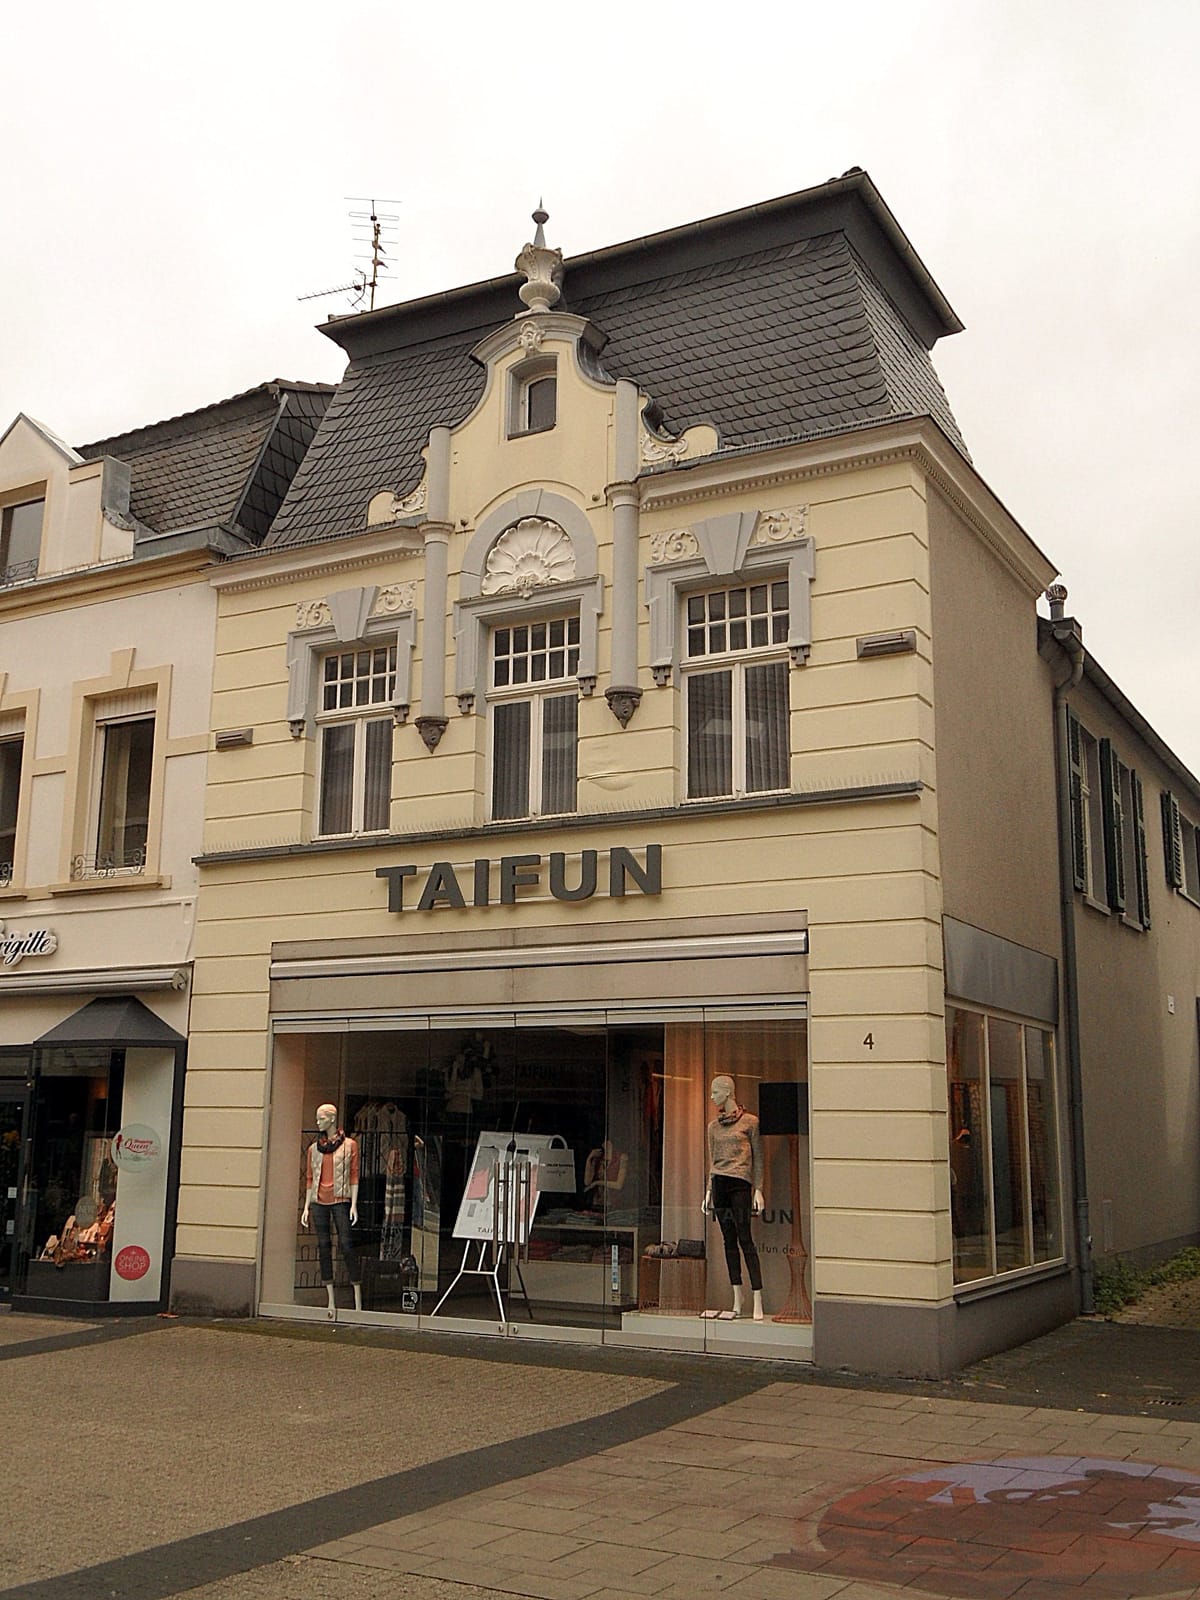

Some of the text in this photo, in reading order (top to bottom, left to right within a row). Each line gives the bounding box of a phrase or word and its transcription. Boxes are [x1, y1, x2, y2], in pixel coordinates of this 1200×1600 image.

[376, 844, 662, 913] TAIFUN
[0, 930, 51, 965] rigitte
[863, 1032, 875, 1050] 4
[119, 1262, 146, 1271] SHOP
